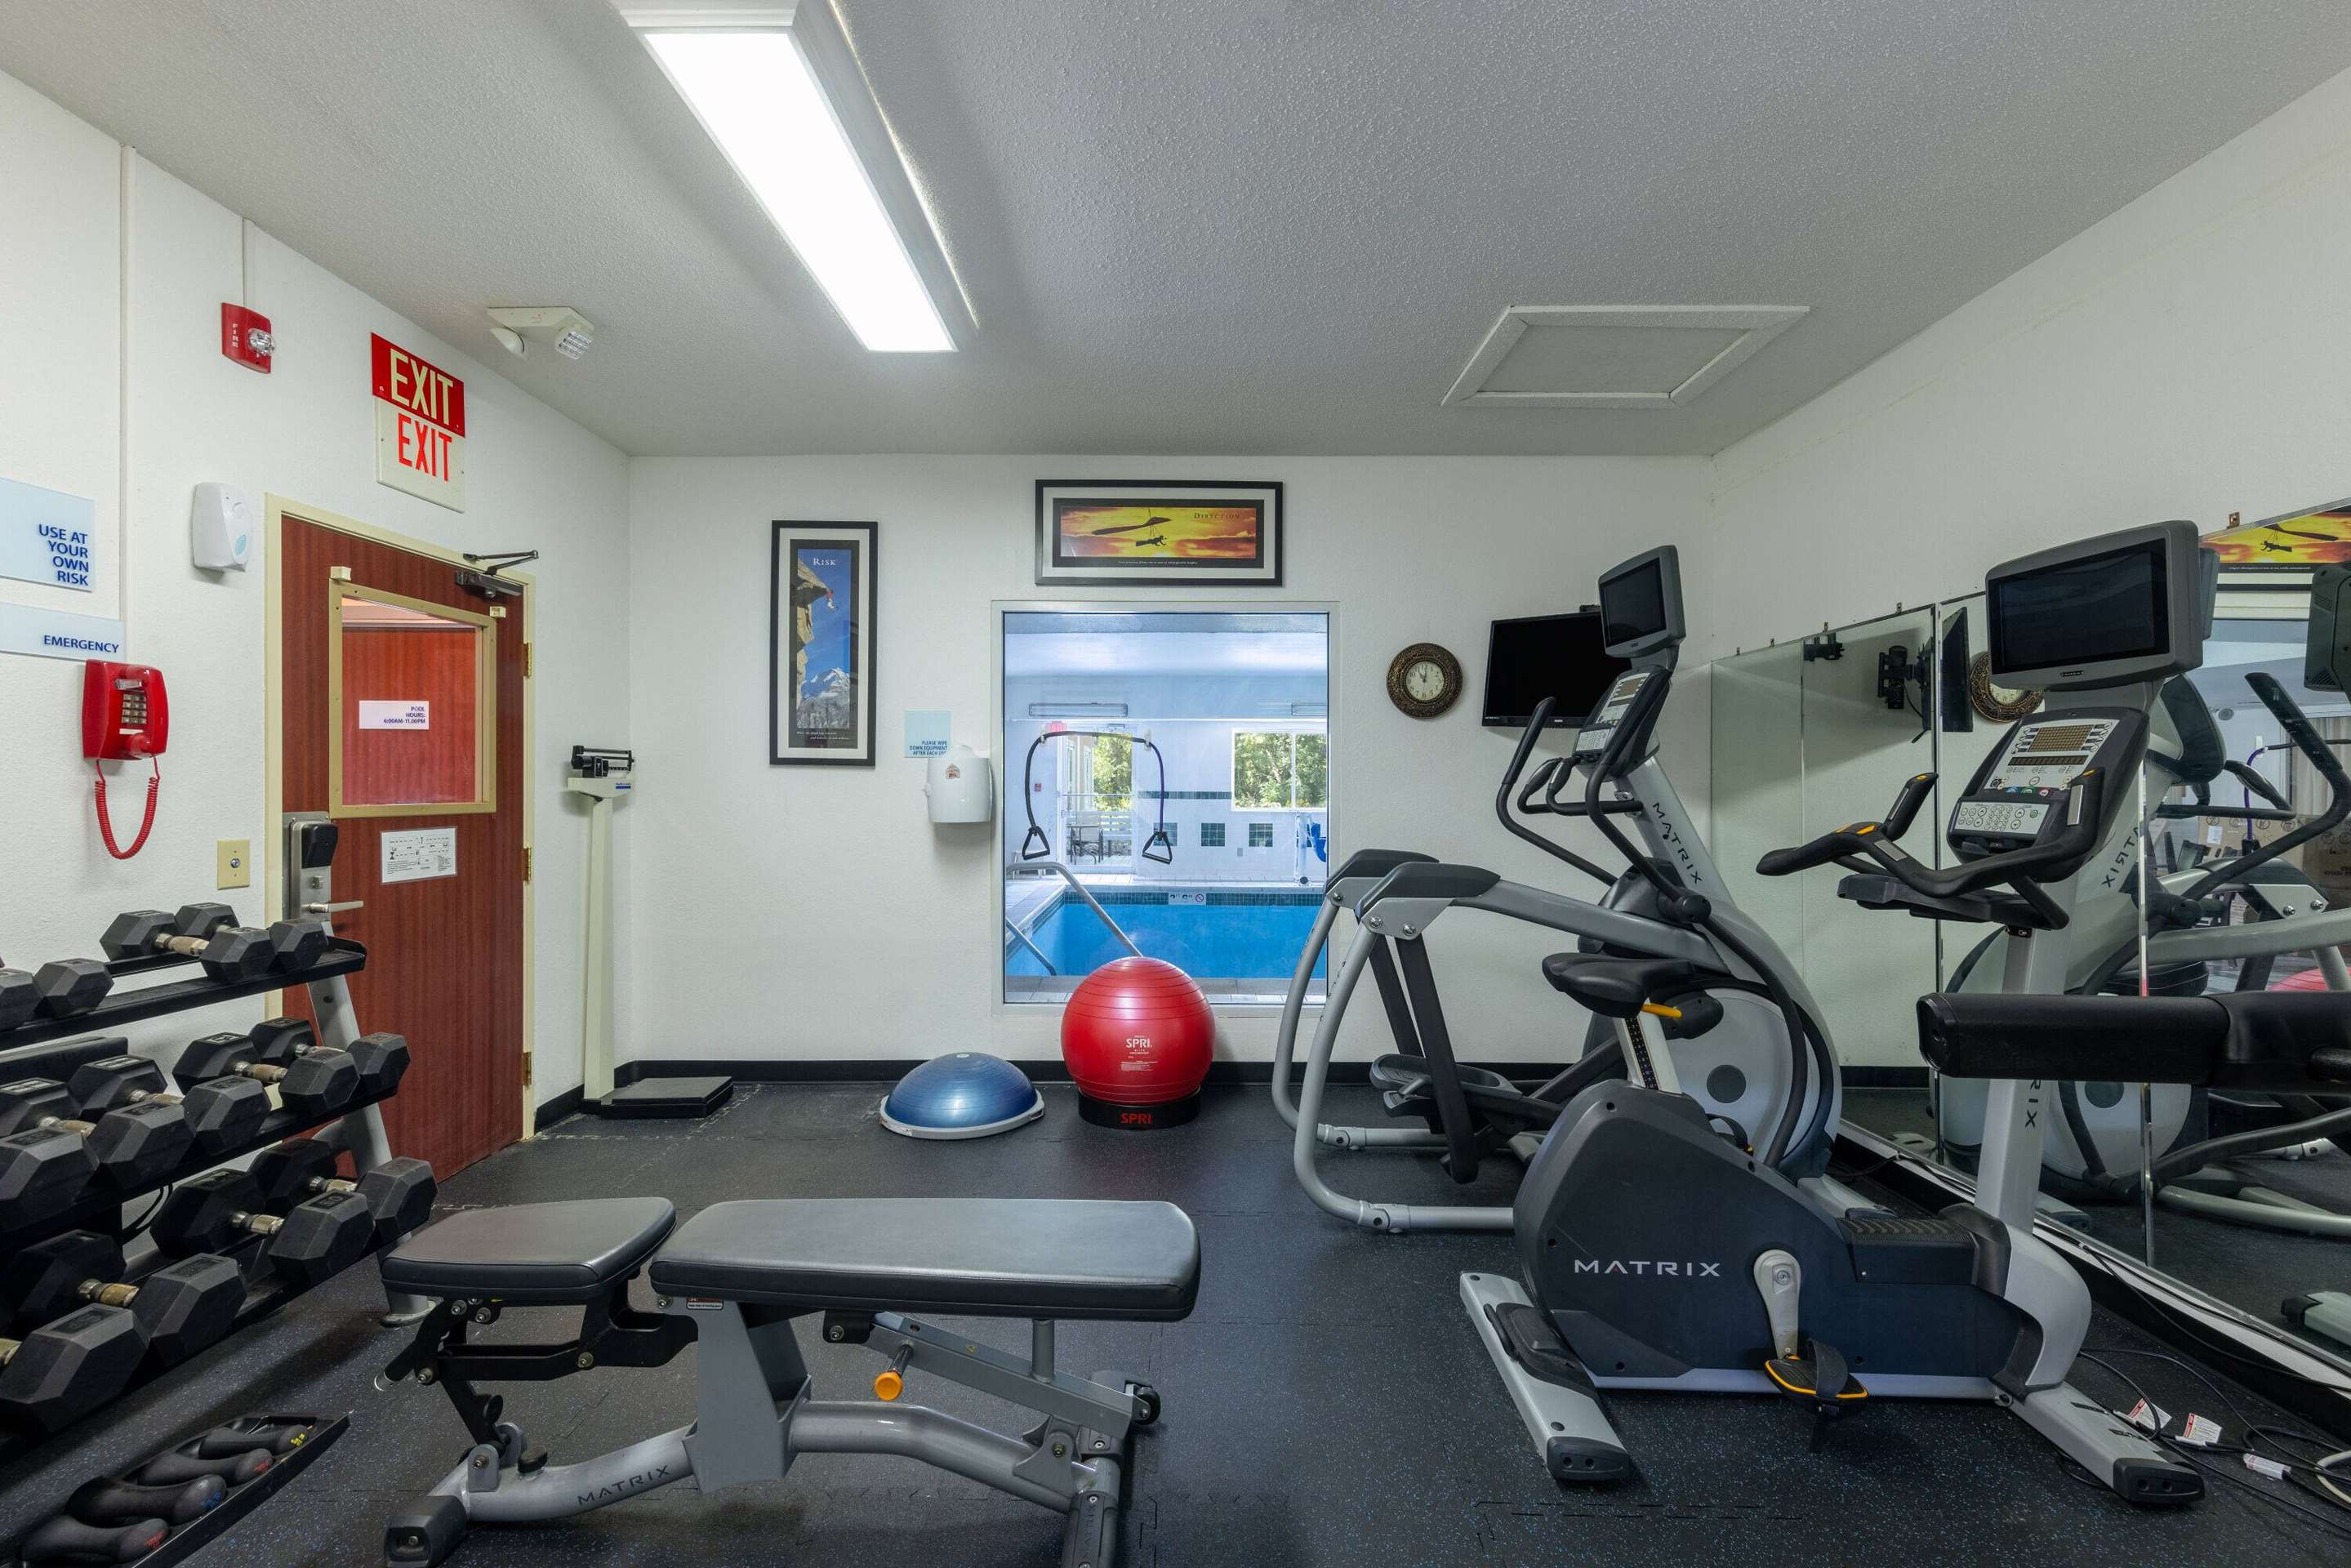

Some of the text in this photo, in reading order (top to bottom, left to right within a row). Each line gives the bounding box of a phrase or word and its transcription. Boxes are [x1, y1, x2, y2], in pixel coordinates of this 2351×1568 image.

[390, 348, 454, 425] EXIT
[397, 412, 452, 482] EXIT
[38, 523, 88, 545] USE AT
[48, 541, 88, 559] YOUR
[52, 556, 89, 572] OWN
[57, 570, 89, 586] RISK
[43, 635, 120, 653] EMERGENCY
[1652, 802, 1703, 884] MATRIX
[1126, 1038, 1151, 1049] SPRI
[1120, 1112, 1151, 1125] SPRI
[1574, 1259, 1721, 1277] MATRIX
[577, 1464, 670, 1506] MATRIX
